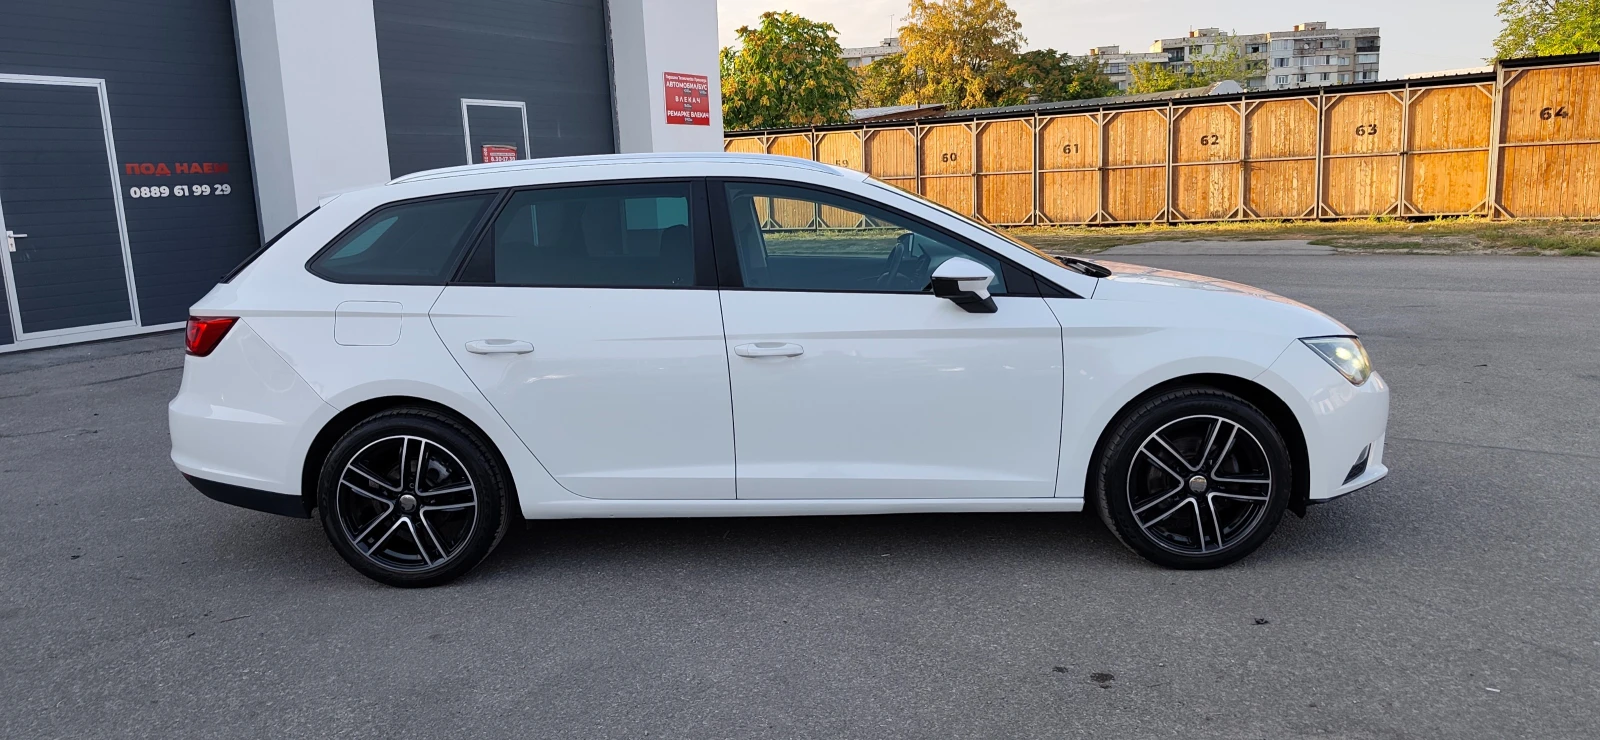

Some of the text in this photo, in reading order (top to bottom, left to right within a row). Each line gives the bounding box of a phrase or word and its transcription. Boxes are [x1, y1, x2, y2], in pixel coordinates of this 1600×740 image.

[1539, 106, 1570, 121] 64
[1355, 123, 1378, 136] 63
[1200, 134, 1220, 146] 62
[1062, 143, 1079, 155] 61
[941, 152, 958, 163] 60
[125, 162, 229, 176] ПОД НАЕМ
[130, 183, 231, 198] 0889 61 99 29
